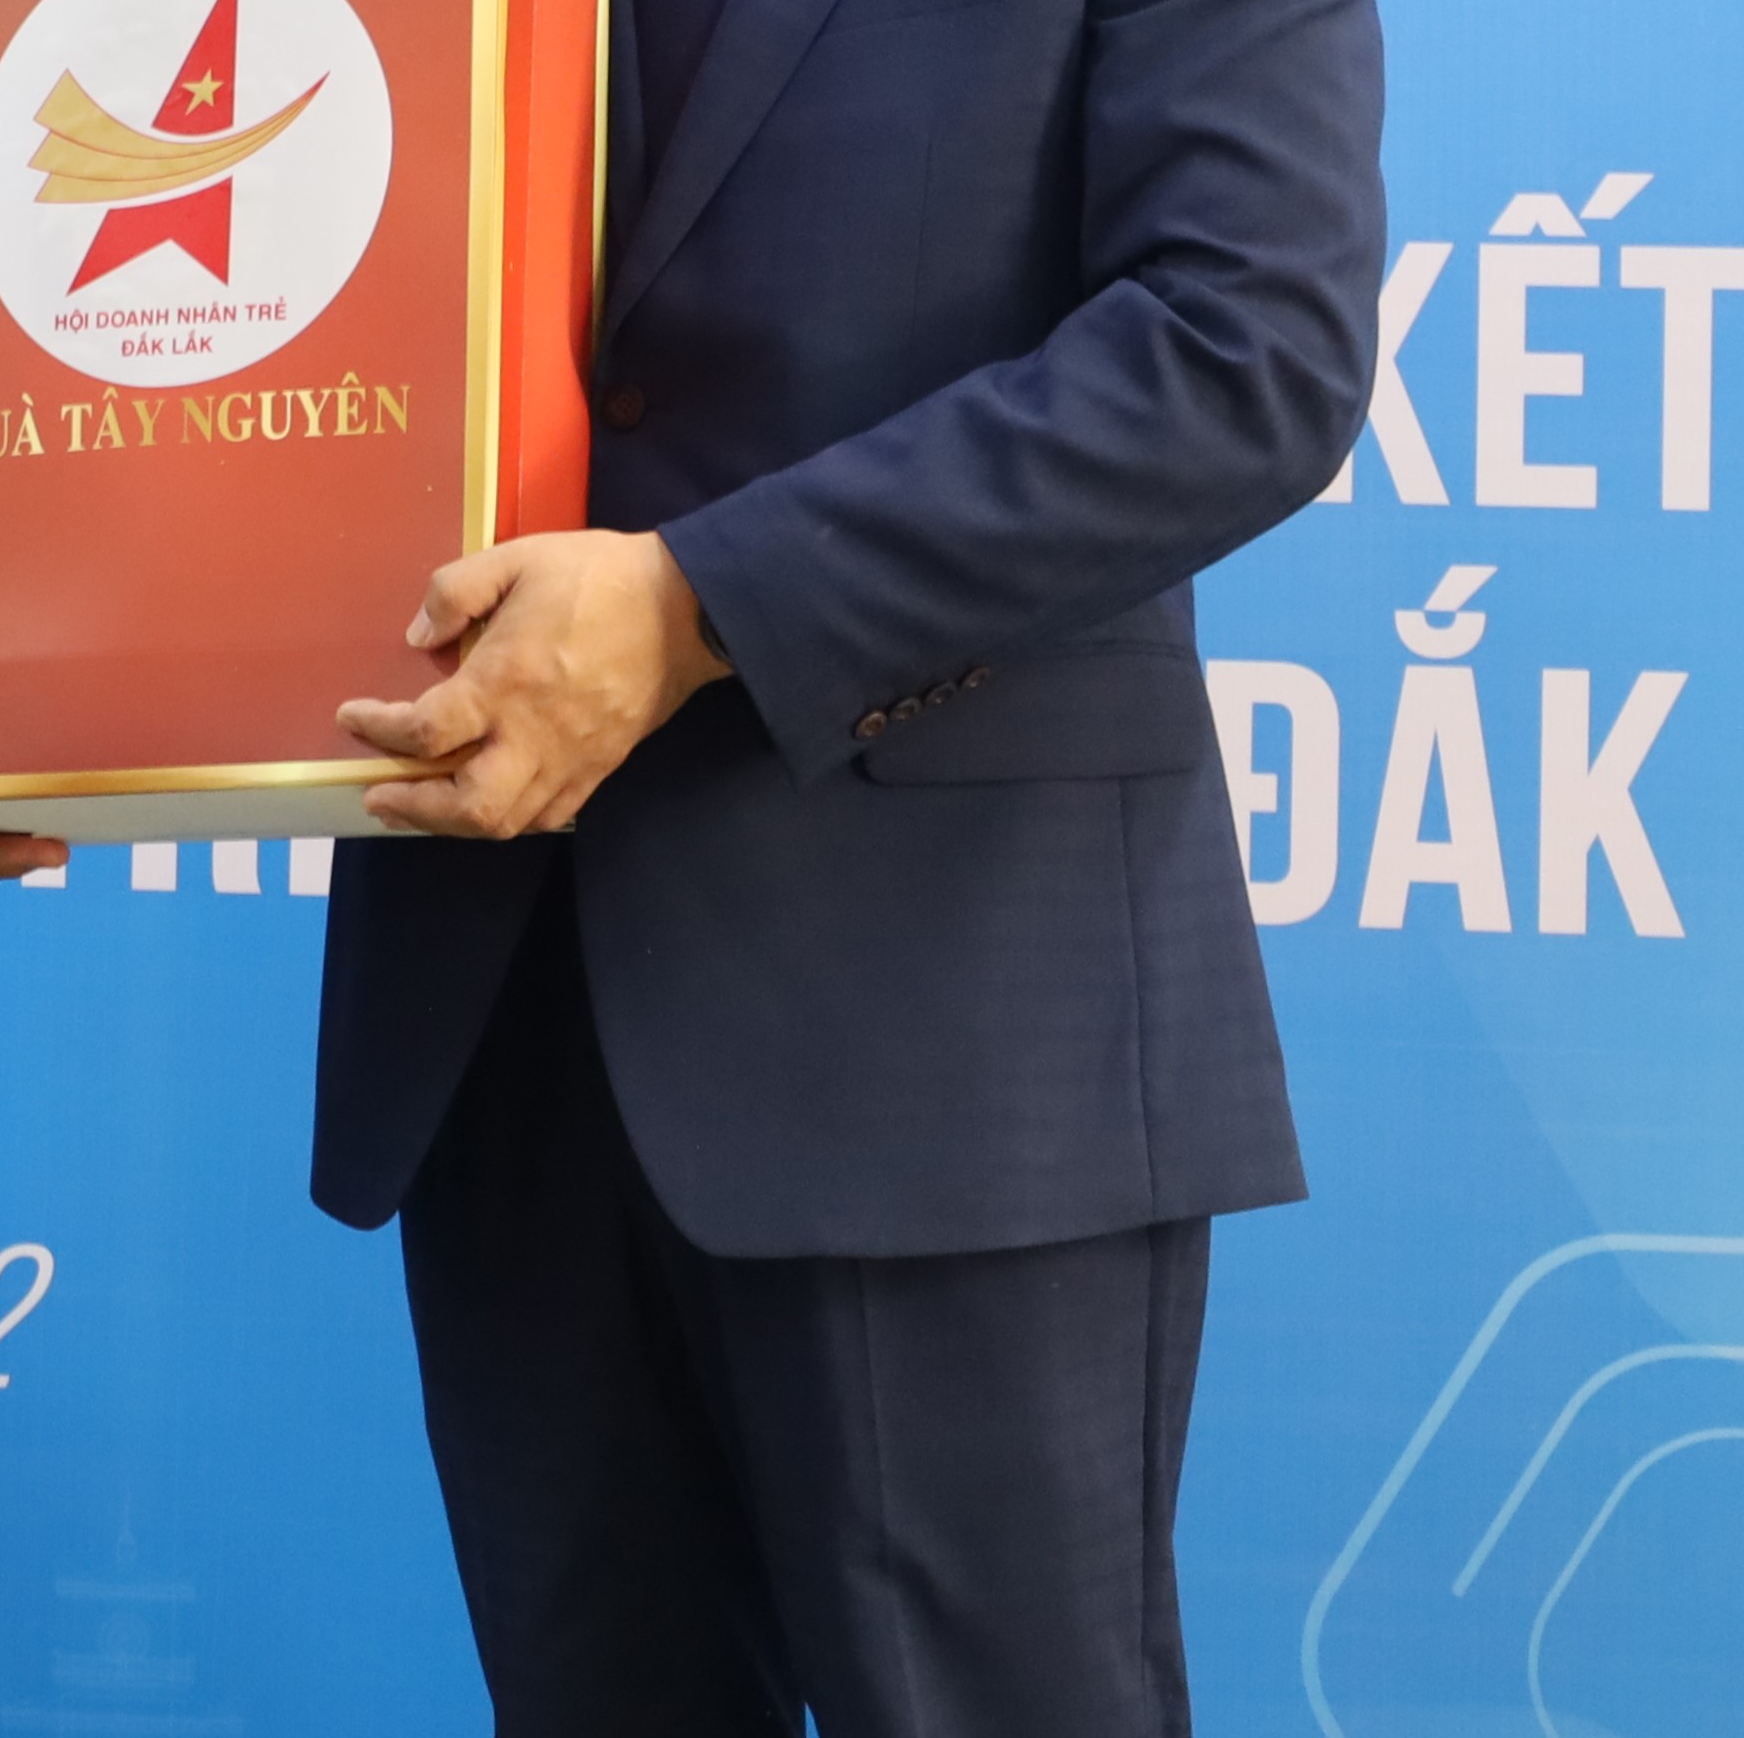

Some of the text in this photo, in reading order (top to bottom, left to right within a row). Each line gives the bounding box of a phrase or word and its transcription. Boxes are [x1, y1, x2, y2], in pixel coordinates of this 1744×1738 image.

[54, 295, 287, 334] HỘI DOANH NHÂN TRẺ
[121, 329, 214, 357] ĐẮK LẮK
[60, 386, 165, 453] TÂY
[180, 370, 412, 444] NGUYÊN
